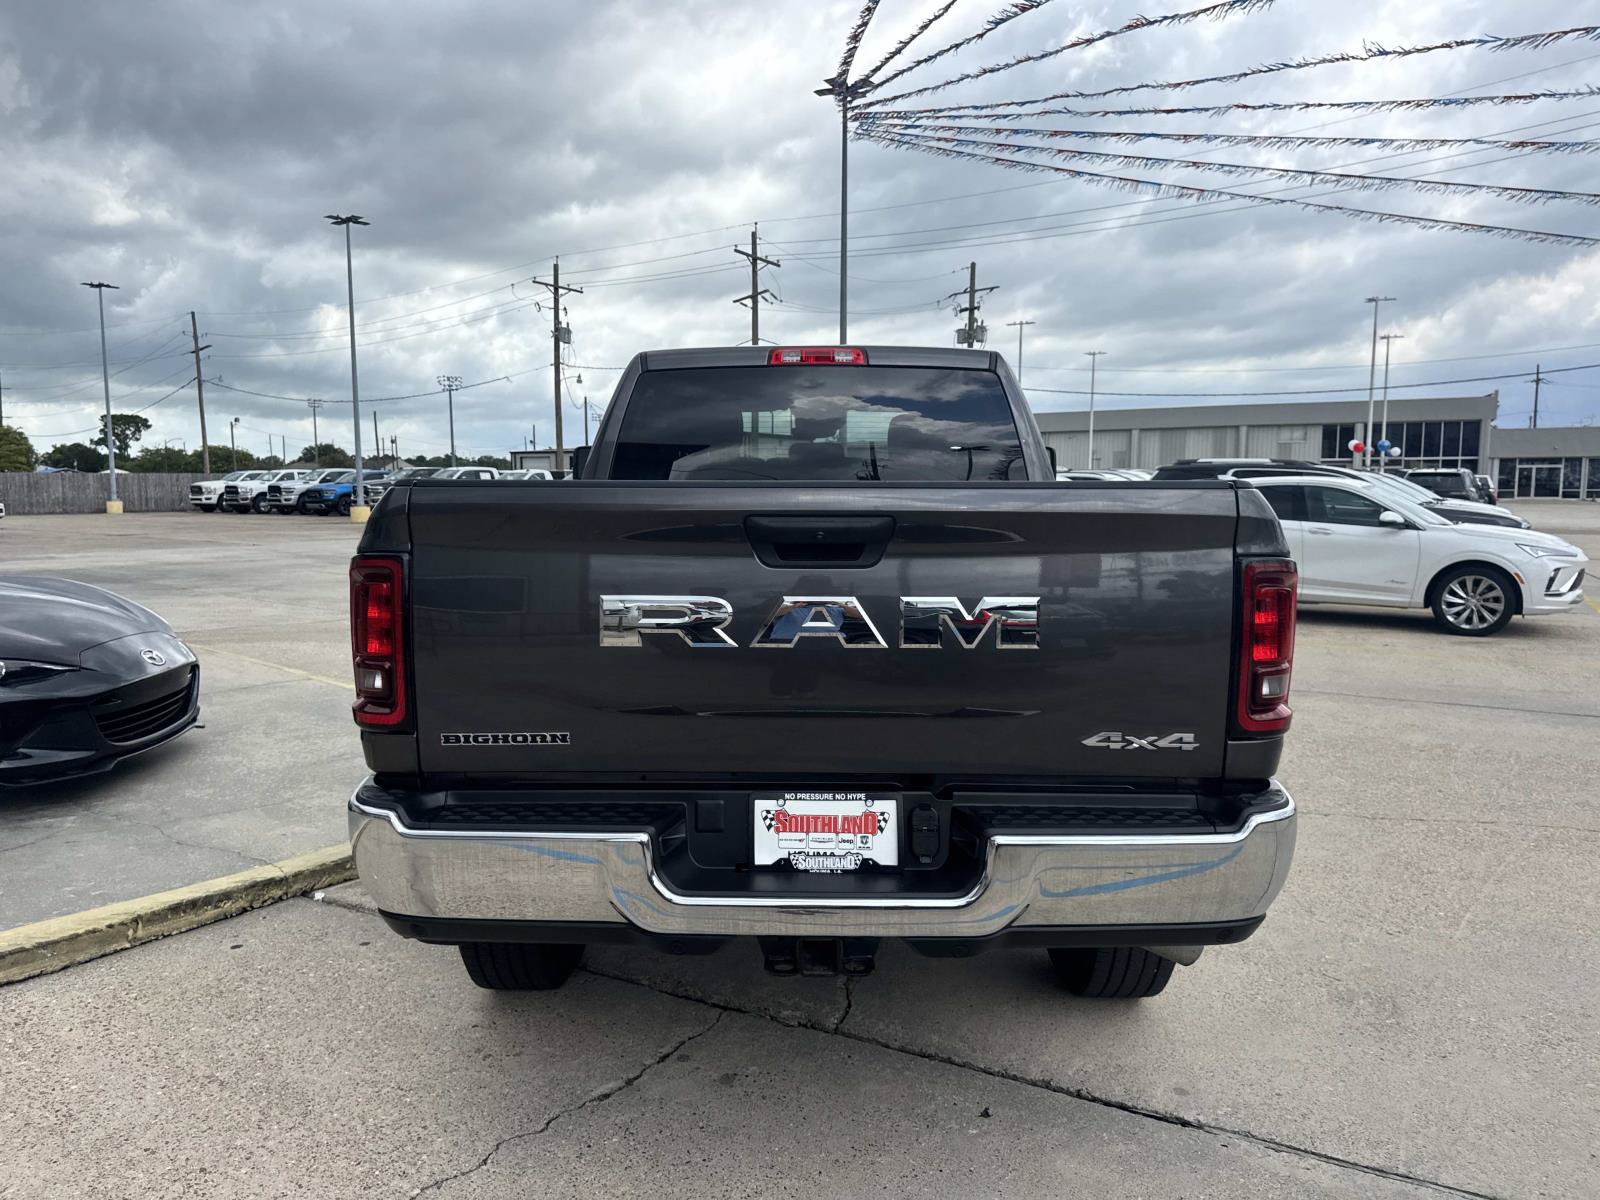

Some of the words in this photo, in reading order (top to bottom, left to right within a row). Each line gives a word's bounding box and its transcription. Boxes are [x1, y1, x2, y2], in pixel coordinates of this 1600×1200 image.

[600, 595, 1040, 648] RAM
[441, 732, 570, 745] BIGHORN
[1081, 731, 1200, 750] 4x4
[774, 810, 878, 835] SOUTHLAND
[798, 854, 855, 869] SOUTHLAND
